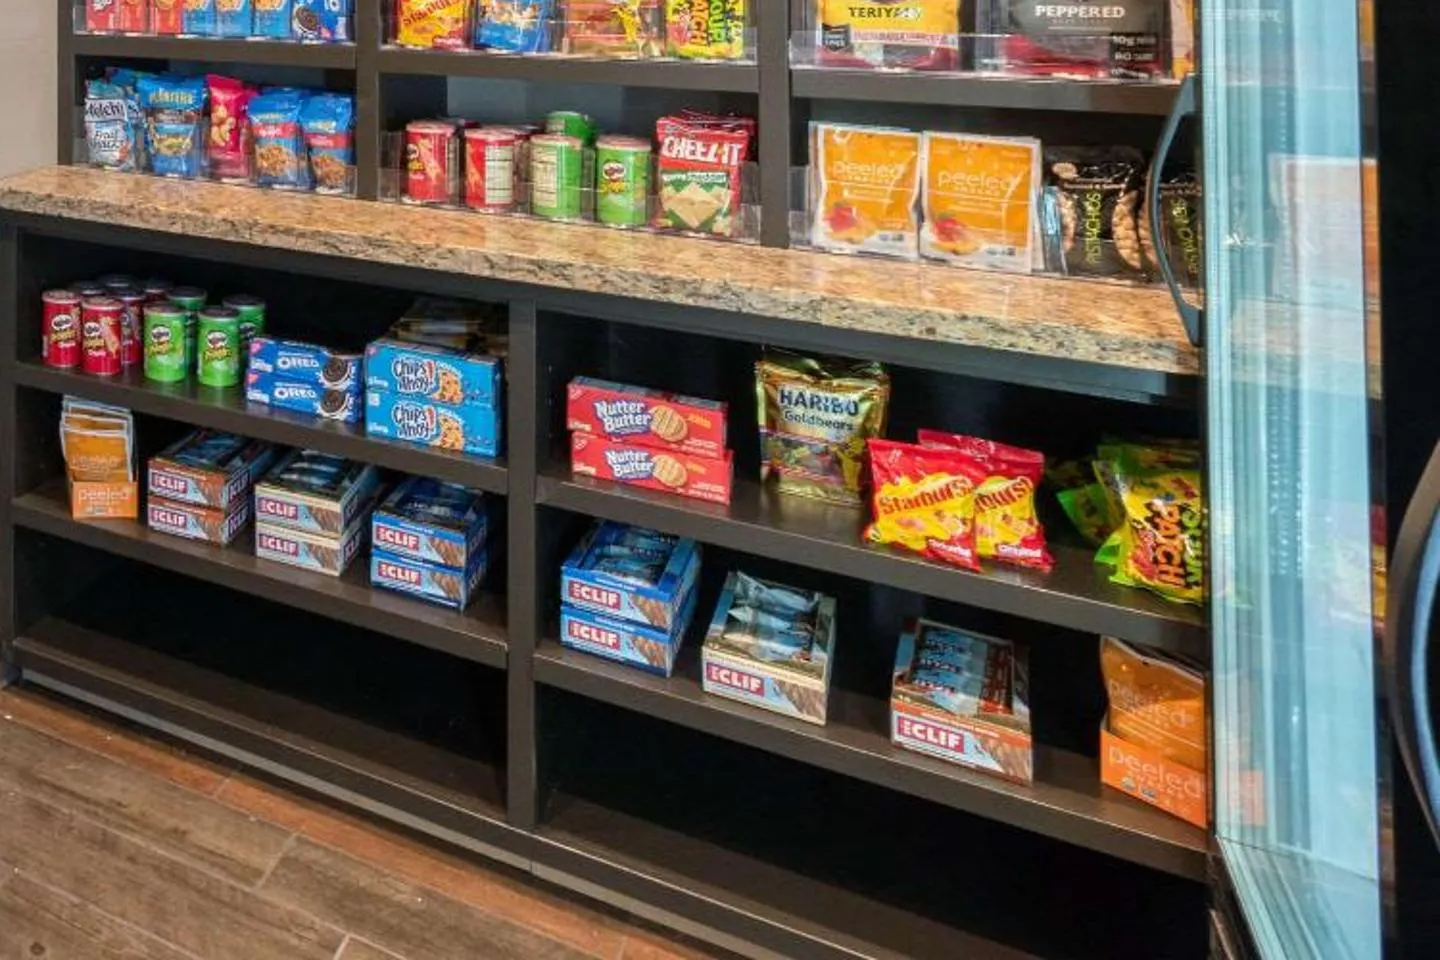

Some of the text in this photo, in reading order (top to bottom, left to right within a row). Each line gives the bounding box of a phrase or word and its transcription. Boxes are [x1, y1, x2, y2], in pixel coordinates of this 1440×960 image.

[1034, 5, 1126, 19] PEPPERED
[277, 356, 320, 370] OREO
[274, 387, 317, 400] OREO
[779, 388, 860, 417] HARIBO
[594, 400, 646, 416] Nutter
[604, 413, 652, 432] Butter
[784, 409, 854, 432] Goldbears
[606, 450, 649, 462] Nutter
[613, 461, 652, 477] Butter
[159, 476, 187, 492] CLIF
[878, 477, 975, 515] Starburst
[975, 476, 1034, 514] burst
[159, 510, 186, 526] CLIF
[267, 501, 297, 517] CLIF
[385, 527, 419, 548] CLIF
[267, 539, 297, 556] CLIF
[387, 565, 421, 585] CLIF
[581, 584, 620, 608] CLIF
[578, 622, 620, 648] CLIF
[717, 668, 764, 694] CLIF
[913, 723, 962, 750] CLIF
